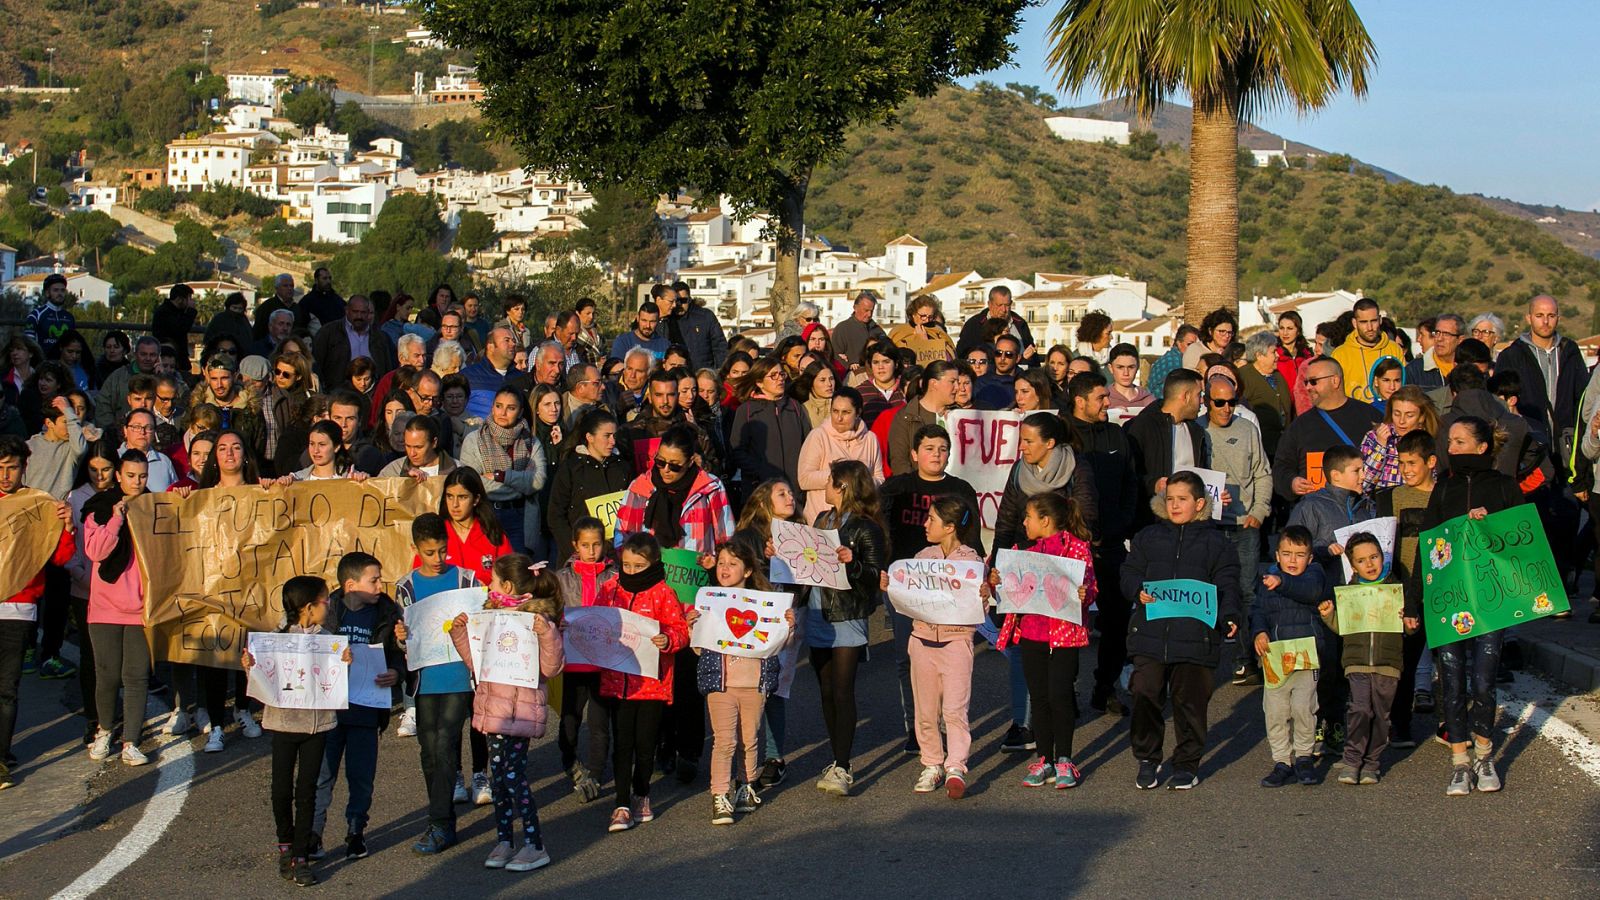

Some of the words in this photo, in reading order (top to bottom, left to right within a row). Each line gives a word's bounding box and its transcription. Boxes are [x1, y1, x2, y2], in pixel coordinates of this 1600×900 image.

[1205, 484, 1219, 502] ZA
[0, 498, 42, 543] EN
[153, 502, 194, 535] EL
[215, 493, 332, 533] PUEBLO
[358, 493, 401, 528] DE
[664, 563, 709, 586] PERANZ
[905, 562, 956, 577] MUCHO
[907, 576, 961, 591] ANIMO
[182, 620, 249, 653] EQUI
